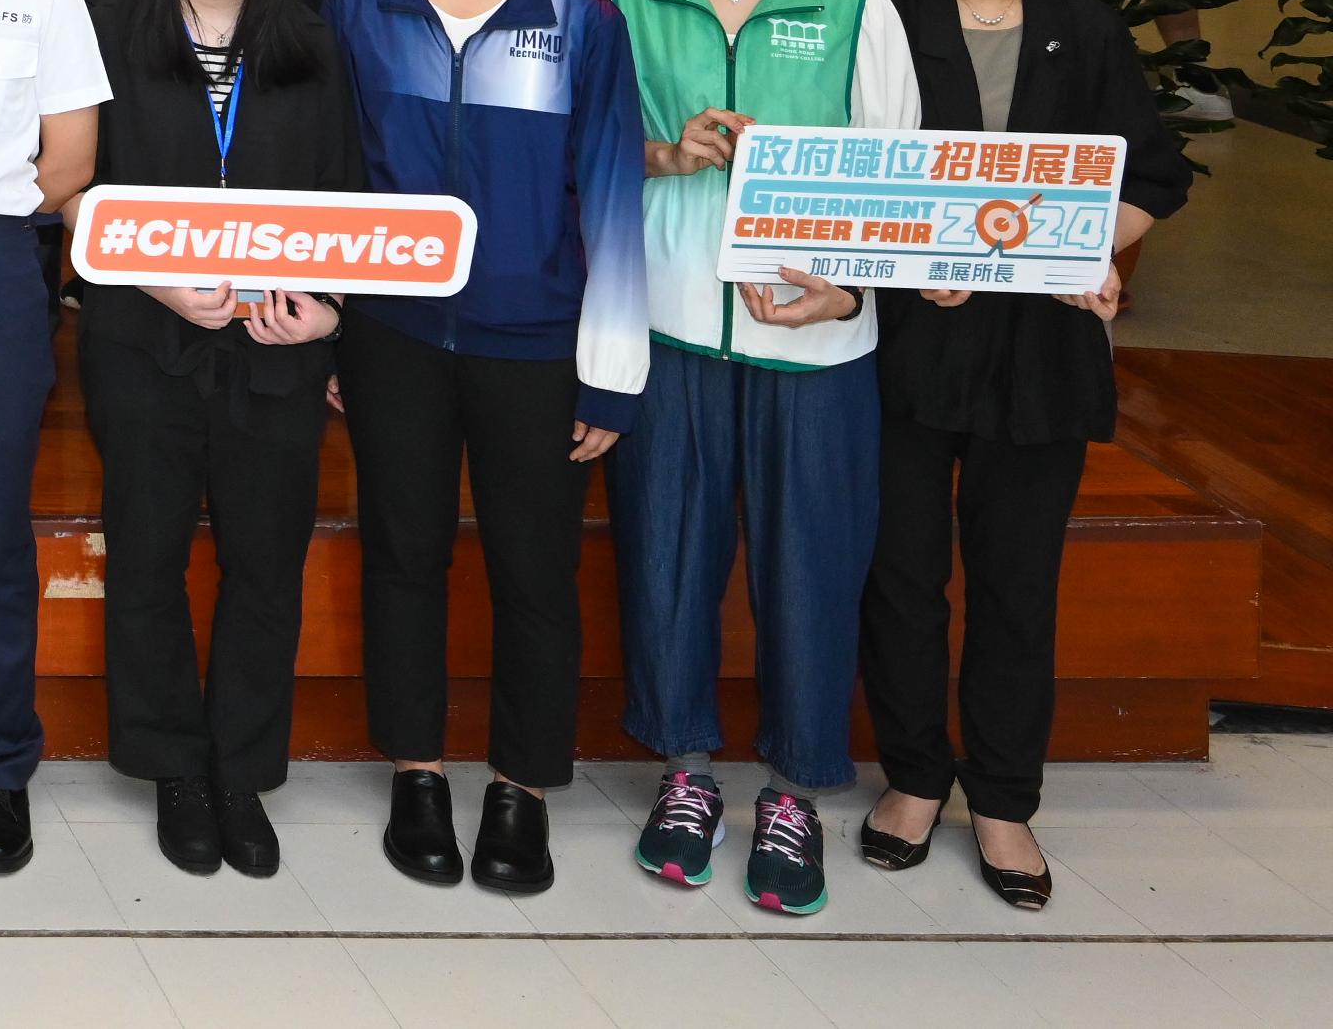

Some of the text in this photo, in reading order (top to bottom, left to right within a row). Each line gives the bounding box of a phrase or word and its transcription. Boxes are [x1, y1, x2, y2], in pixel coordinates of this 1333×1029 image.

[516, 30, 563, 54] IMMD
[744, 134, 1118, 187] 政府職位招聘展覽
[99, 218, 444, 267] #CivilService
[733, 216, 933, 245] CAREER FAIR
[936, 198, 1108, 251] 2024
[810, 257, 1016, 284] 加入政府 盡展所長
